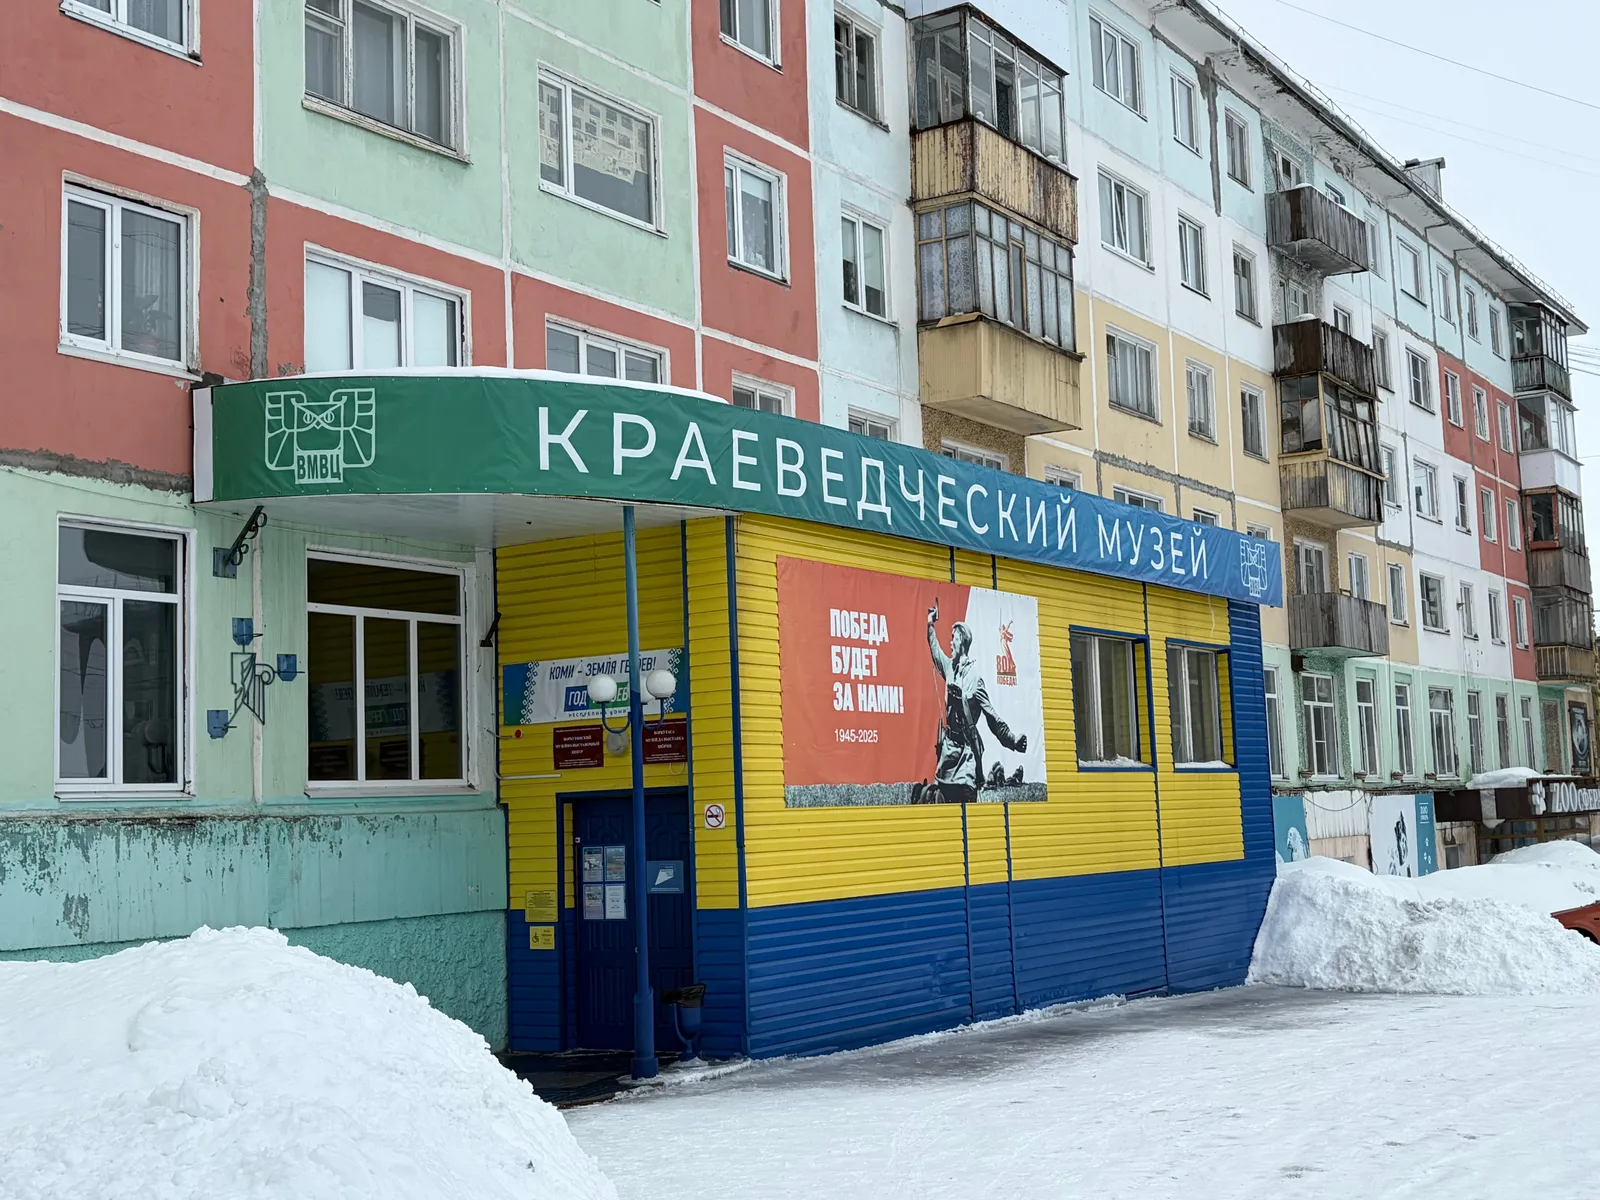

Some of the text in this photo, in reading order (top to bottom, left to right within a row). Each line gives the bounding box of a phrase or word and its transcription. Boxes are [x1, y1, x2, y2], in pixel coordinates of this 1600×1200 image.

[296, 454, 343, 482] ВМВЦ
[538, 406, 1208, 580] КРАЕВЕДЧЕСКИЙ МУЗЕЙ
[829, 608, 890, 646] ПОБЕДА
[549, 664, 575, 681] КОМИ
[585, 660, 617, 677] ЗЕМЛЯ
[619, 656, 657, 674] ГЕЕВ!
[830, 645, 878, 680] БУДЕТ
[568, 690, 587, 707] ГОД
[832, 681, 905, 714] ЗА НАМИ!
[834, 728, 879, 743] 1945-2025
